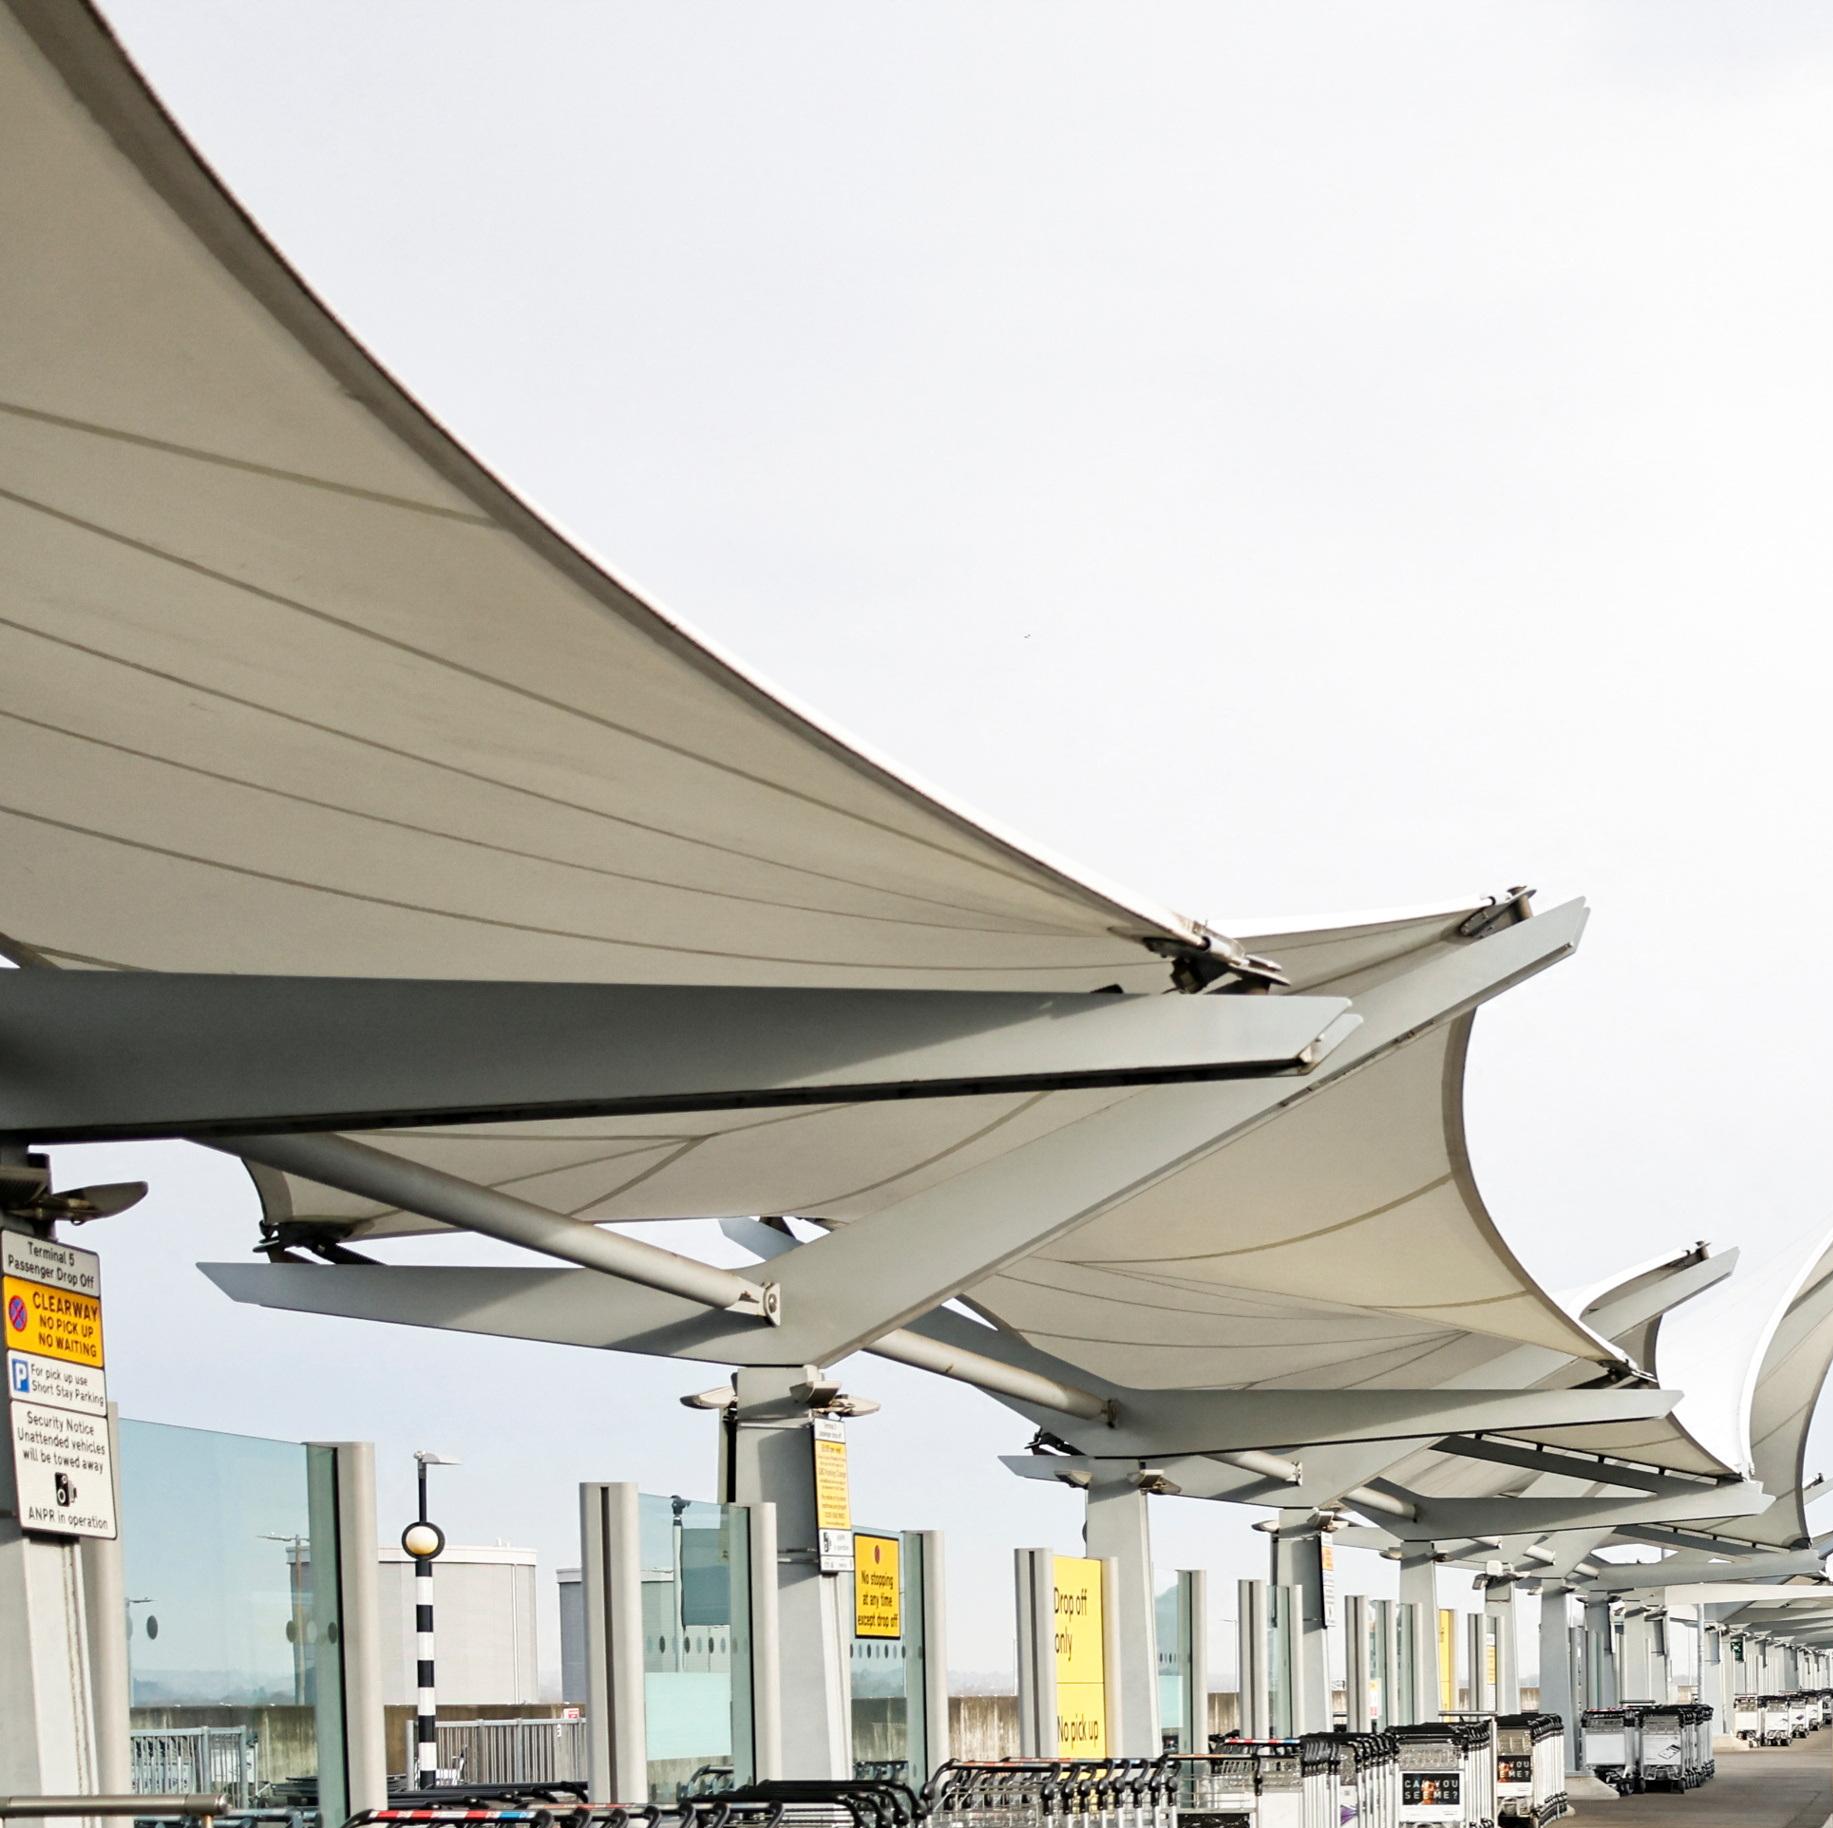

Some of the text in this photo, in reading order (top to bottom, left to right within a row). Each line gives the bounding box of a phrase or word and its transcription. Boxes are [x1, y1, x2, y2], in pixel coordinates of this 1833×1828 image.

[28, 1241, 75, 1266] Terminal 5
[8, 1254, 94, 1288] Passenger Drop Off
[32, 1291, 98, 1321] CLEARWAY
[40, 1314, 94, 1338] NO PICK UP
[38, 1332, 97, 1357] NO WAITING
[30, 1363, 88, 1386] For pick up use
[32, 1380, 104, 1407] Short Stay Parking
[27, 1411, 94, 1435] Security Notice
[18, 1427, 105, 1455] Unattended vehicles
[23, 1447, 103, 1474] will be towed away
[29, 1506, 108, 1529] ANPR in operation
[861, 1570, 893, 1590] No stopping
[863, 1592, 892, 1609] at any time
[1054, 1587, 1087, 1622] Drop off
[858, 1612, 898, 1629] except drop off
[1054, 1627, 1073, 1662] only
[1057, 1713, 1099, 1749] No pick up
